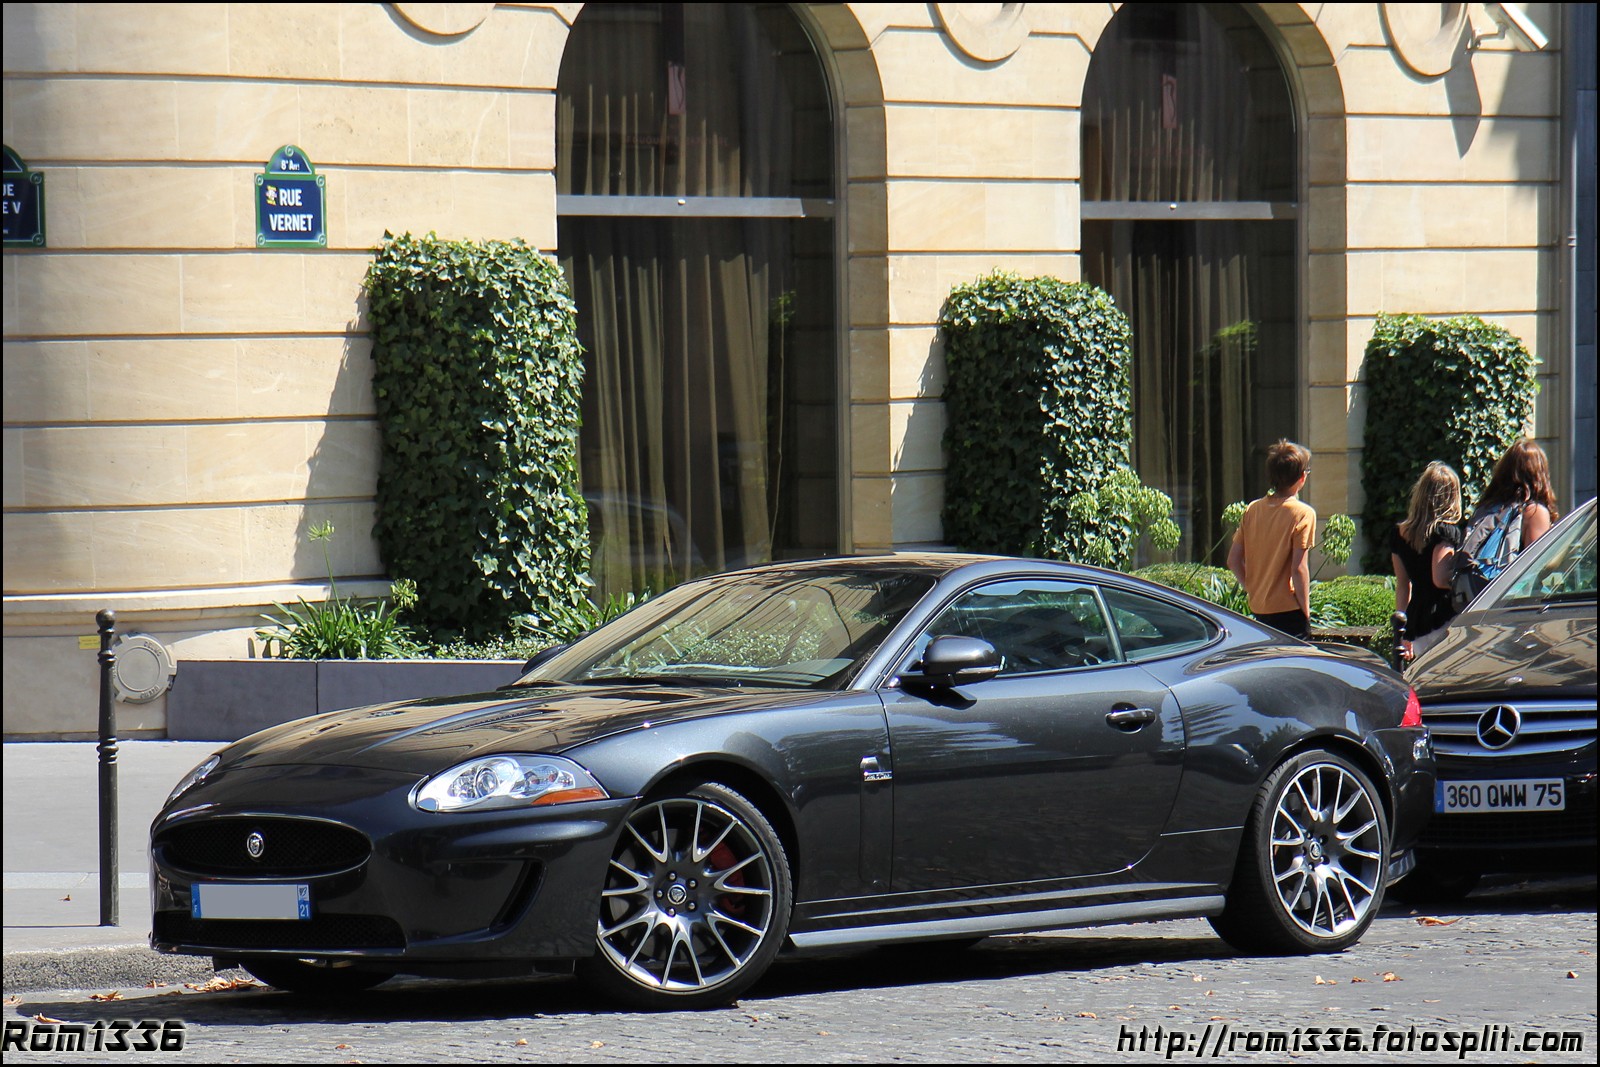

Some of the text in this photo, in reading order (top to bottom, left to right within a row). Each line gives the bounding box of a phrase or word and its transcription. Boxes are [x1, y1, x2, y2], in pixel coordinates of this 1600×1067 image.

[279, 188, 302, 206] RUE
[12, 201, 21, 214] V
[269, 213, 313, 231] VERNET
[1447, 783, 1562, 808] 360 QWW 75
[299, 904, 309, 917] 21
